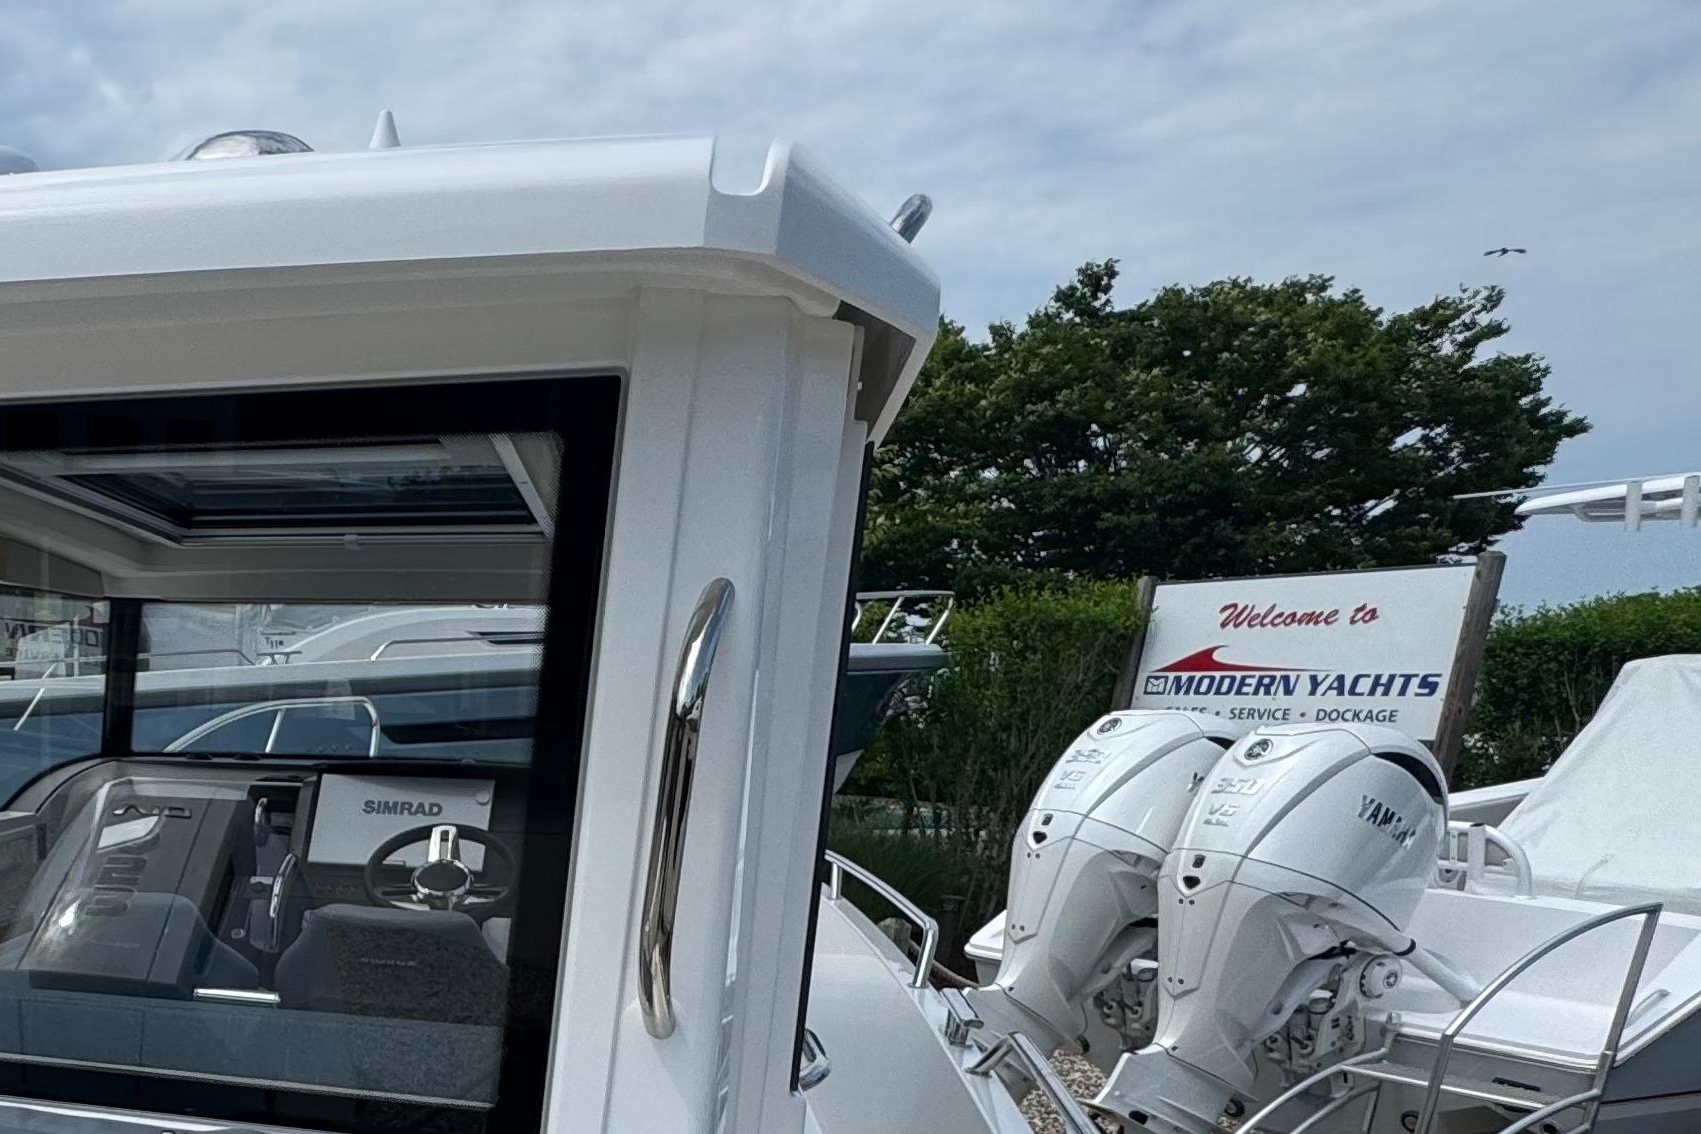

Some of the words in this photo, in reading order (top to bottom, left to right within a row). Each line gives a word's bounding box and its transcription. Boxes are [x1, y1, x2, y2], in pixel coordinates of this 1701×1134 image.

[1218, 602, 1340, 630] Welcome
[1349, 602, 1380, 625] to
[1166, 674, 1300, 697] MODERN
[1308, 672, 1443, 697] YACHTS
[1228, 707, 1291, 722] SERVICE
[1314, 708, 1399, 724] DOCKAGE
[362, 799, 443, 817] SIMRAD
